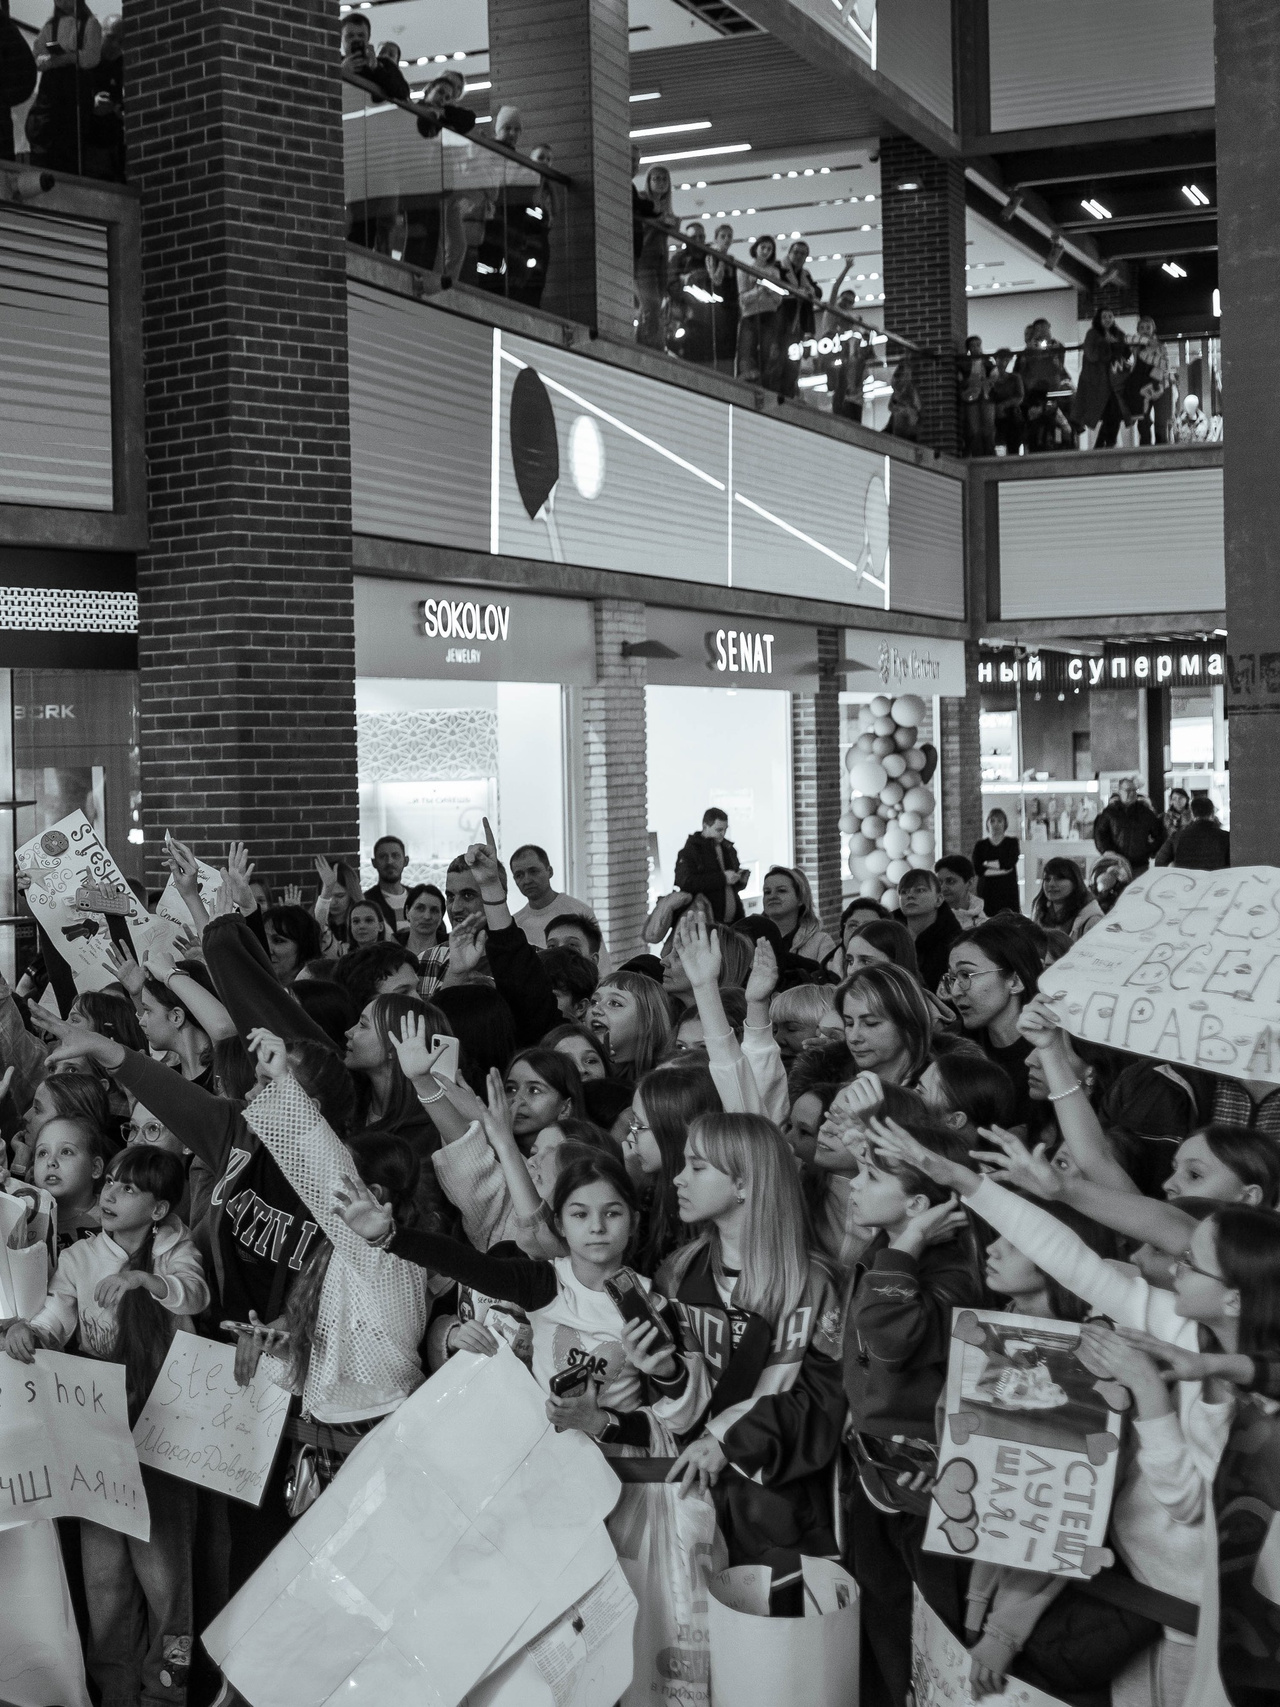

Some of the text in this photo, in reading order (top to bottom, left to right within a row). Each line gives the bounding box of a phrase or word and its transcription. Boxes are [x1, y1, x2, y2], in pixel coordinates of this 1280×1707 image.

[424, 598, 510, 641] SOKOLOV
[445, 648, 481, 663] JEWELRY
[716, 629, 775, 674] SENAT
[977, 656, 1042, 682] ный
[1068, 653, 1224, 685] суперма
[567, 1347, 608, 1376] STAR
[211, 1402, 233, 1430] &
[135, 1425, 201, 1468] Макар
[1048, 1460, 1098, 1573] СТЕША
